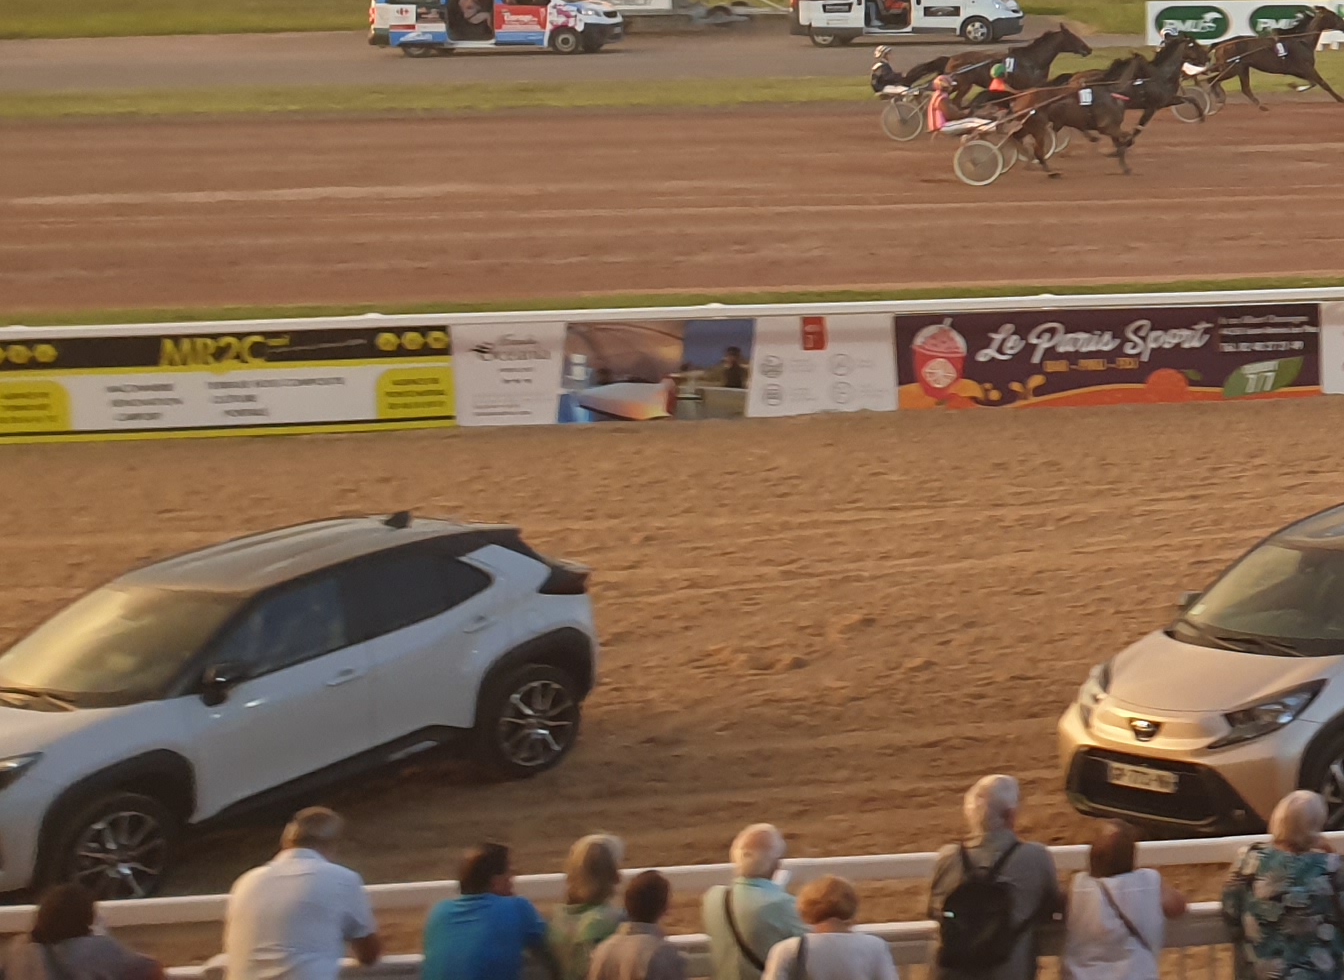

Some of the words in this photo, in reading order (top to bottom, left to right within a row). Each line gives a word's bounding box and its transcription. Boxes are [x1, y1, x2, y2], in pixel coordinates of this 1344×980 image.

[974, 323, 1026, 362] Le
[1027, 321, 1121, 364] Paris
[1122, 318, 1215, 363] Sport
